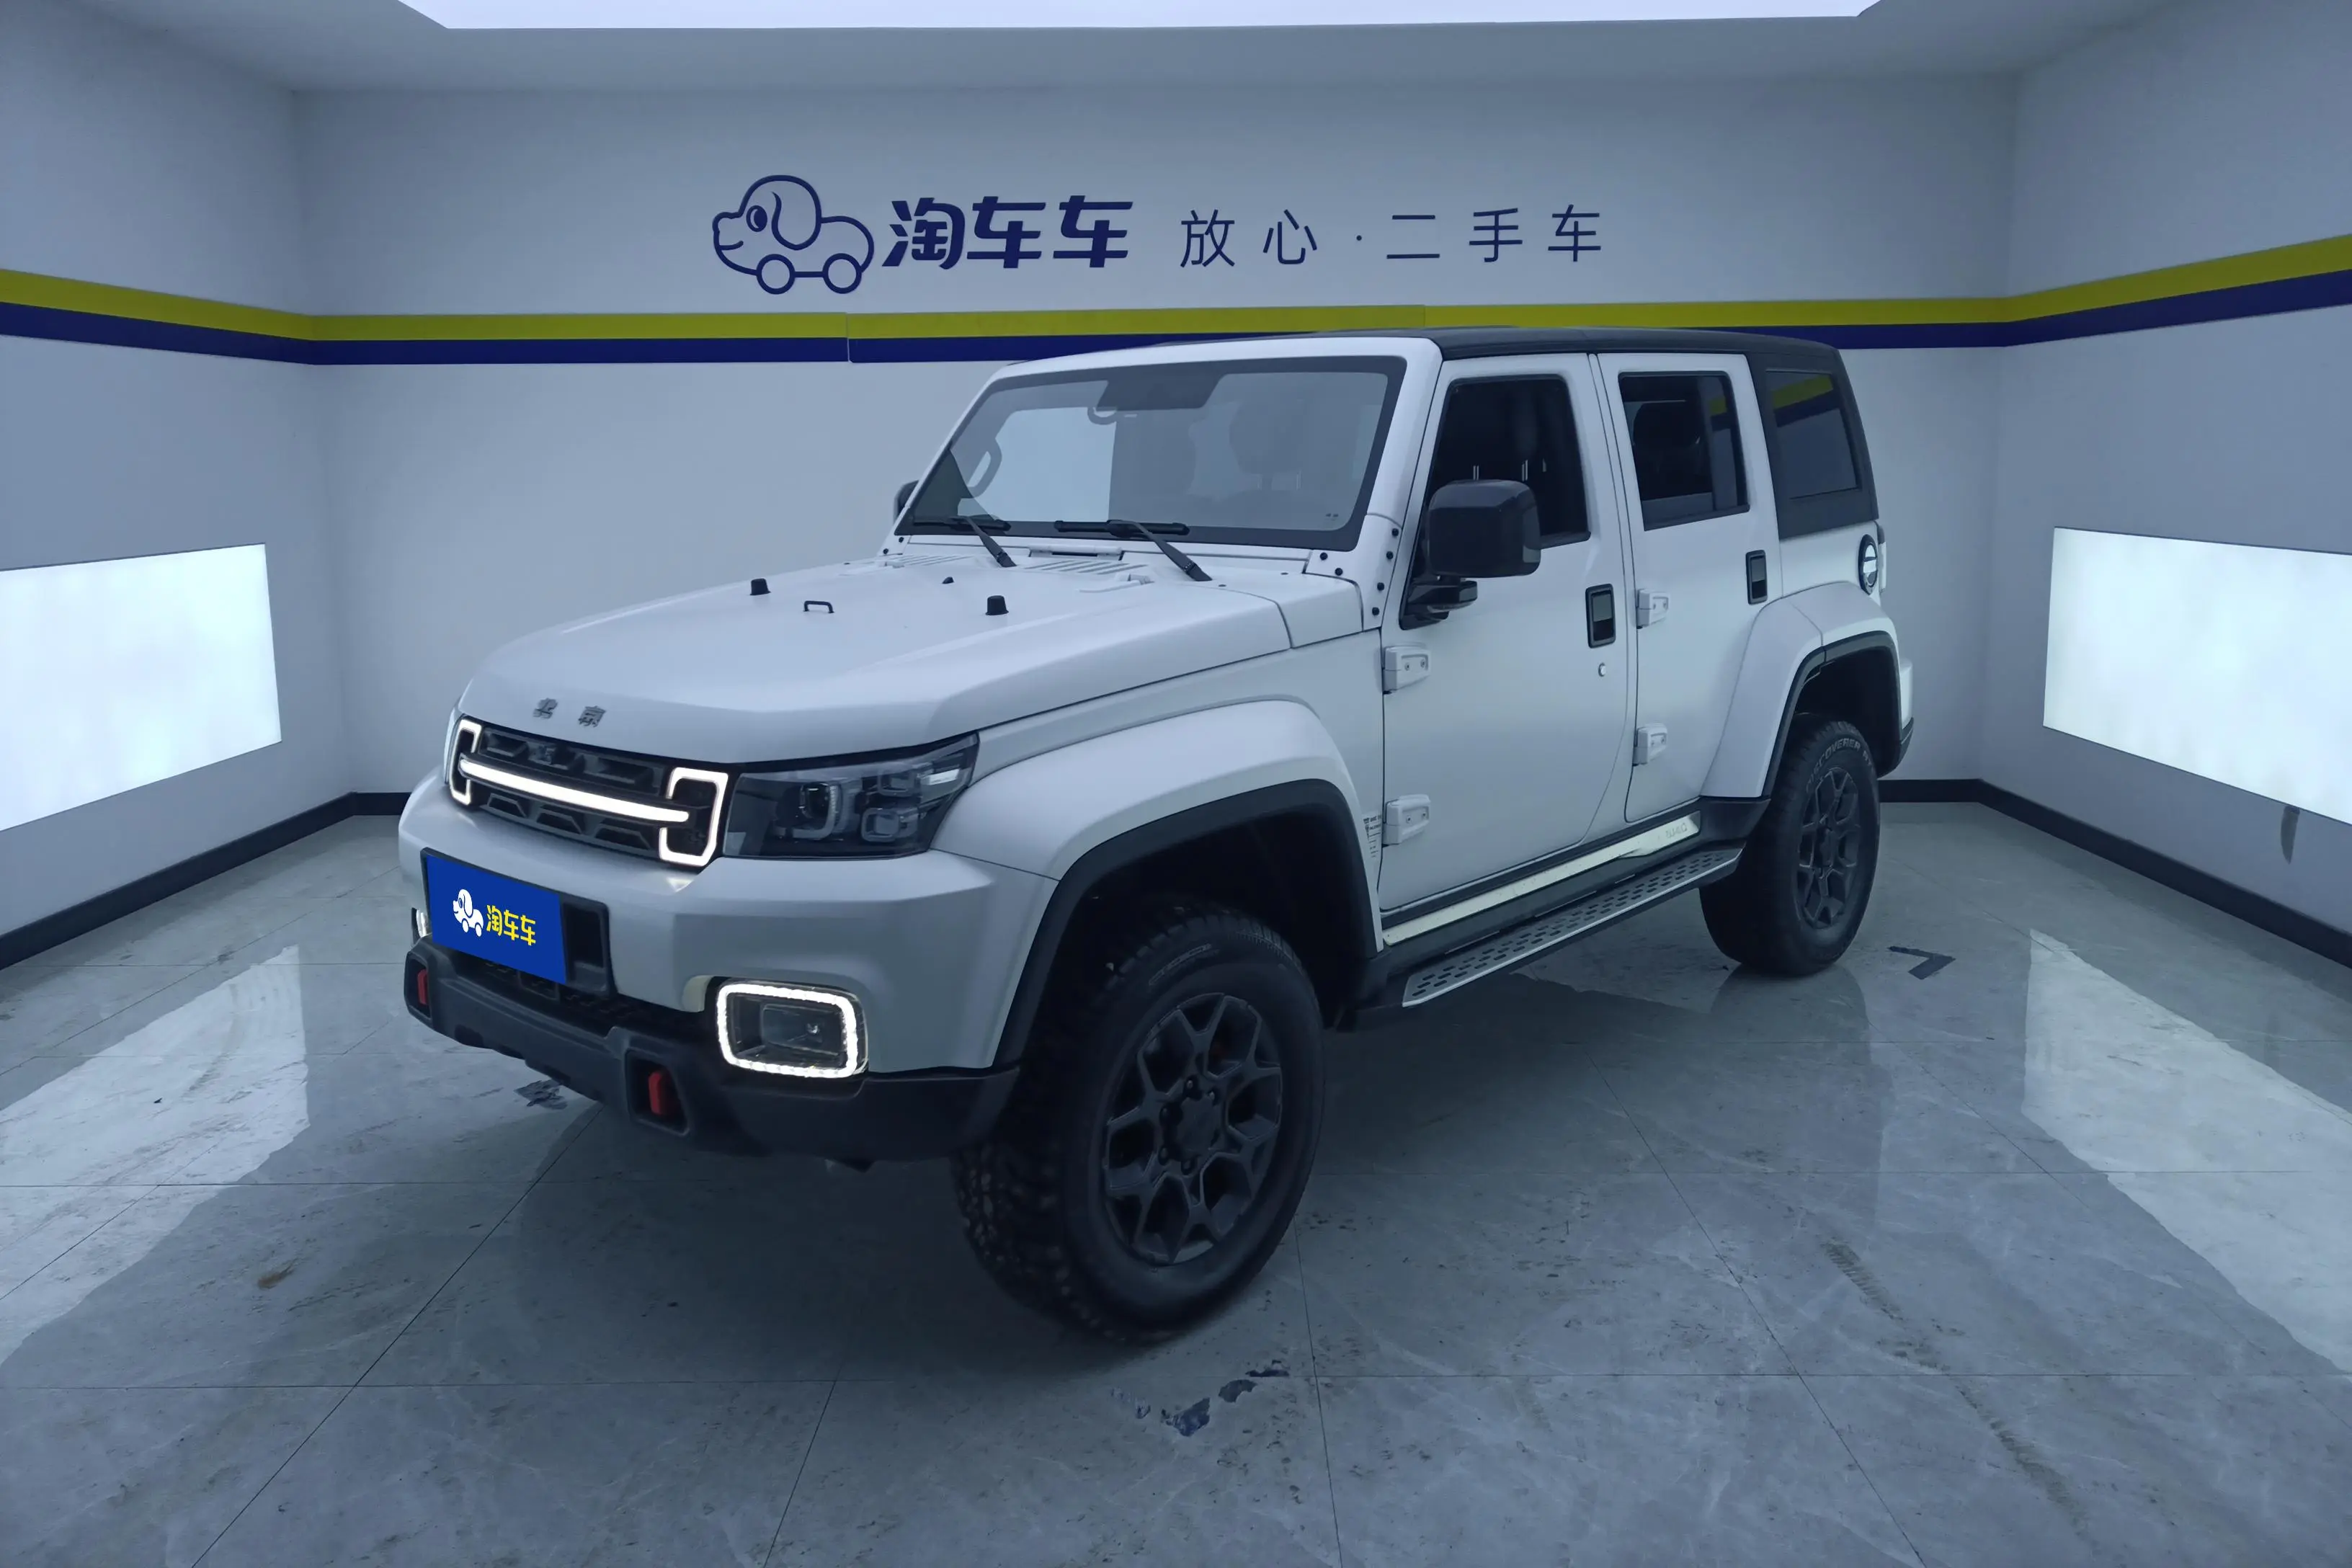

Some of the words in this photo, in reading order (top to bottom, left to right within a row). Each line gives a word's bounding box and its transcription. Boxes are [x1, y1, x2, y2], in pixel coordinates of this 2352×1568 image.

[881, 195, 1133, 270] 淘车车
[533, 698, 607, 728] 北京
